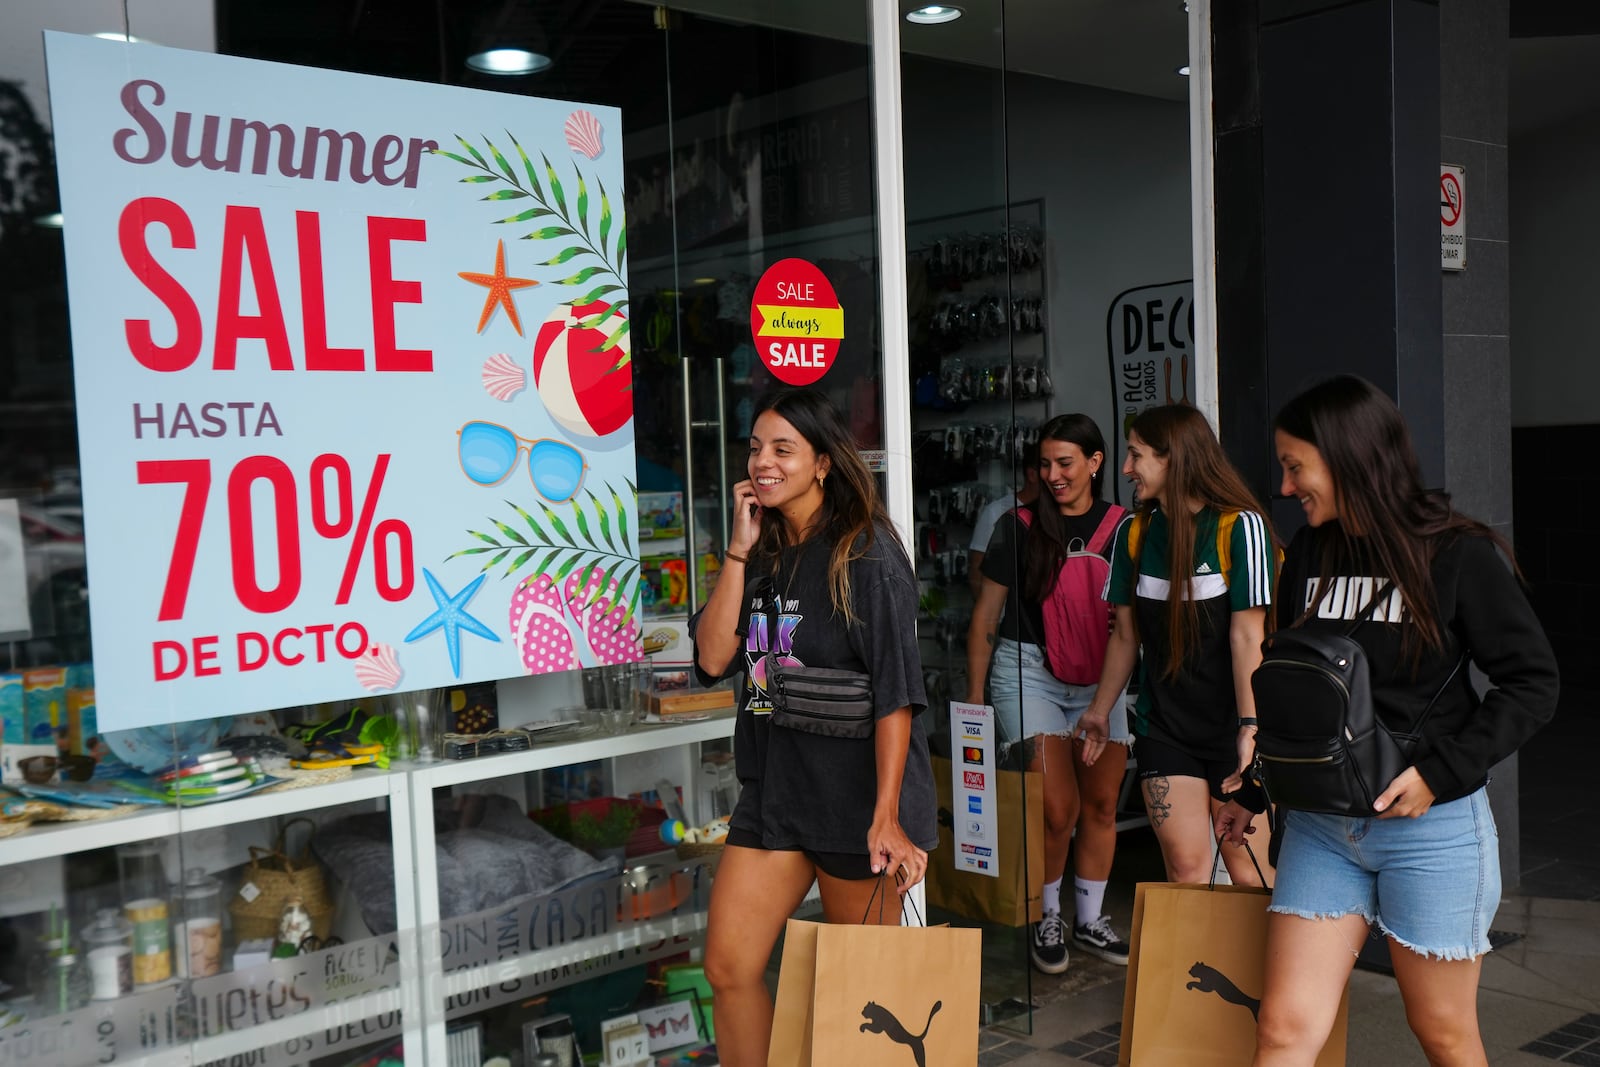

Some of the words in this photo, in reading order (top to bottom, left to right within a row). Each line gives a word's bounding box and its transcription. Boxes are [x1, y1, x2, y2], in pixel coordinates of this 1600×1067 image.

[113, 79, 438, 189] Summer
[1441, 234, 1463, 245] OHIBIDO
[118, 196, 434, 373] SALE
[776, 281, 815, 301] SALE
[772, 311, 820, 335] always
[1123, 296, 1194, 355] DEC
[769, 342, 826, 368] SALE
[1123, 361, 1142, 402] ACCE
[1144, 359, 1157, 401] SORIOS
[133, 402, 283, 440] HASTA
[136, 453, 415, 622] 70%
[152, 635, 222, 682] DE
[236, 621, 380, 672] DCTO.
[965, 726, 981, 735] VISA
[528, 886, 608, 951] CASA
